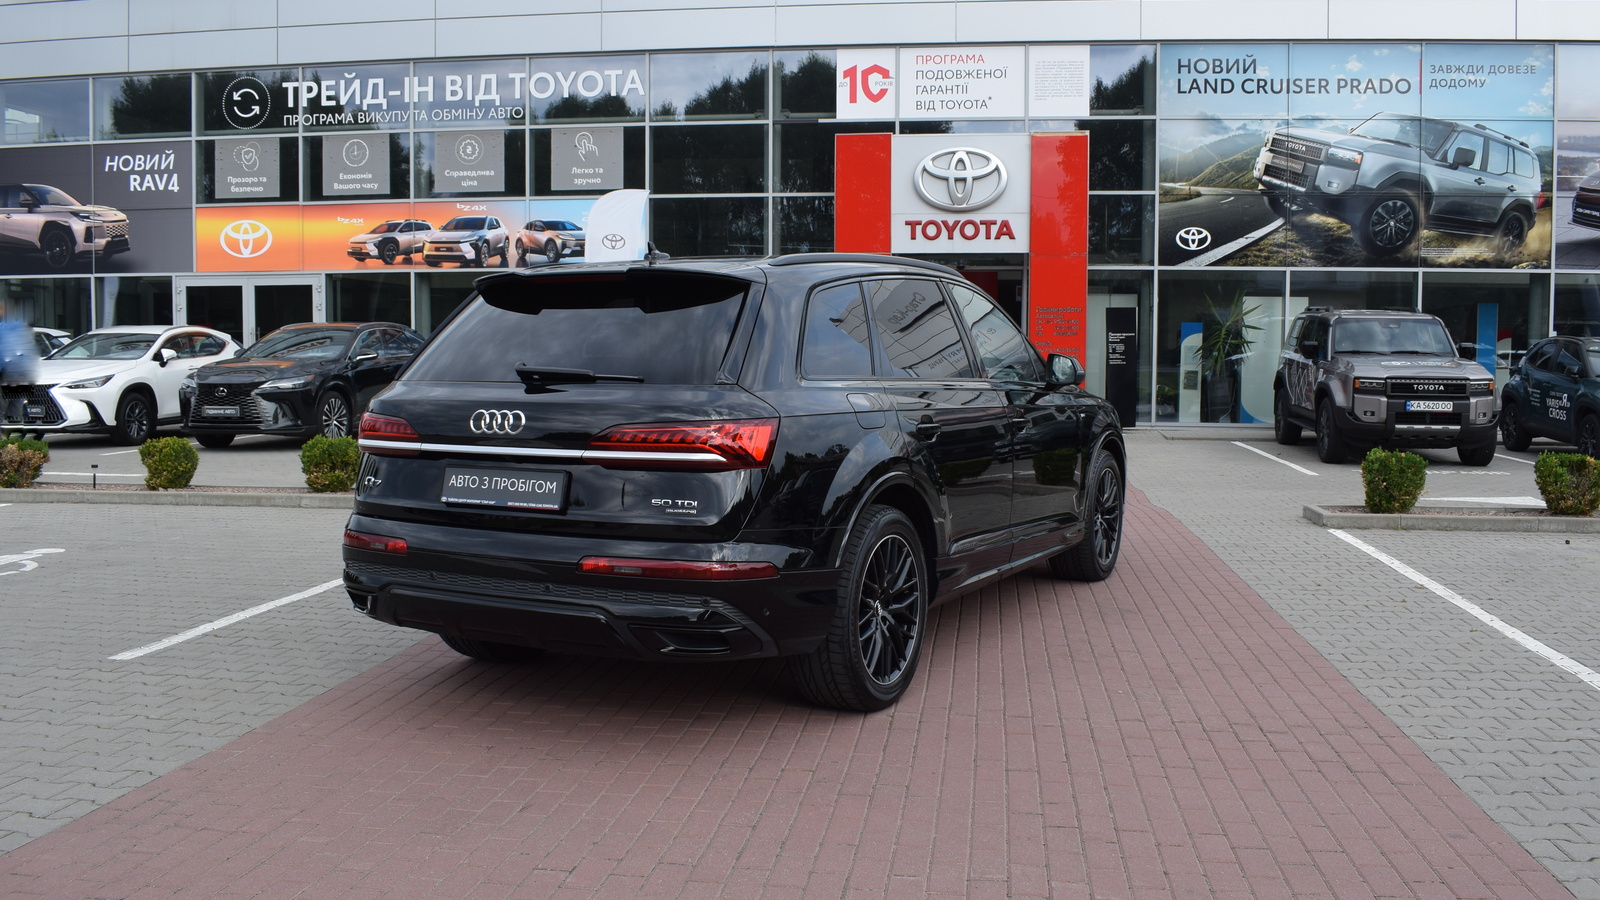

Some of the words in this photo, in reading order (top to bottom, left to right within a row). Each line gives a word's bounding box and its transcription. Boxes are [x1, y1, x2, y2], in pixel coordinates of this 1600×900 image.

[916, 54, 985, 66] ПРОГРАМА
[1177, 54, 1258, 75] НОВИЙ
[916, 66, 1008, 82] ПОДОВЖЕНОЇ
[1429, 63, 1485, 76] ЗАВЖДИ
[1487, 63, 1537, 76] ДОВЕЗЕ
[874, 80, 894, 88] РОКІВ
[916, 82, 968, 95] ГАРАНТІЇ
[1177, 78, 1236, 96] LAND
[1240, 78, 1331, 95] CRUISER
[1336, 78, 1412, 95] PRADO
[1429, 77, 1487, 90] ДОДОМУ
[282, 72, 434, 111] ТРЕЙД-ІН
[445, 73, 501, 106] ВІД
[509, 69, 646, 100] TOYOTA
[916, 100, 936, 112] ВІД
[283, 112, 356, 127] ПРОГРАМА
[358, 110, 410, 125] ВИКУПУ
[414, 111, 428, 122] ТА
[432, 107, 486, 121] ОБМІНУ
[488, 106, 524, 119] АВТО
[1285, 141, 1306, 151] TOYOTA
[105, 149, 175, 173] НОВИЙ
[339, 172, 373, 180] Економія
[444, 169, 495, 178] Справедлива
[571, 167, 593, 175] Легко
[129, 172, 180, 192] RAV4
[227, 176, 258, 184] Прозоро
[333, 182, 361, 190] Вашого
[362, 182, 379, 190] часу
[461, 179, 478, 187] ціна
[573, 177, 601, 185] зручно
[905, 219, 1016, 241] TOYOTA
[1422, 402, 1440, 410] 5620
[1545, 398, 1559, 408] YARIS
[1548, 408, 1567, 420] CROSS
[365, 476, 382, 487] Q7
[448, 474, 480, 488] АВТО
[491, 477, 557, 494] ПРОБІГОМ
[651, 499, 672, 507] 50
[675, 499, 698, 508] TDI
